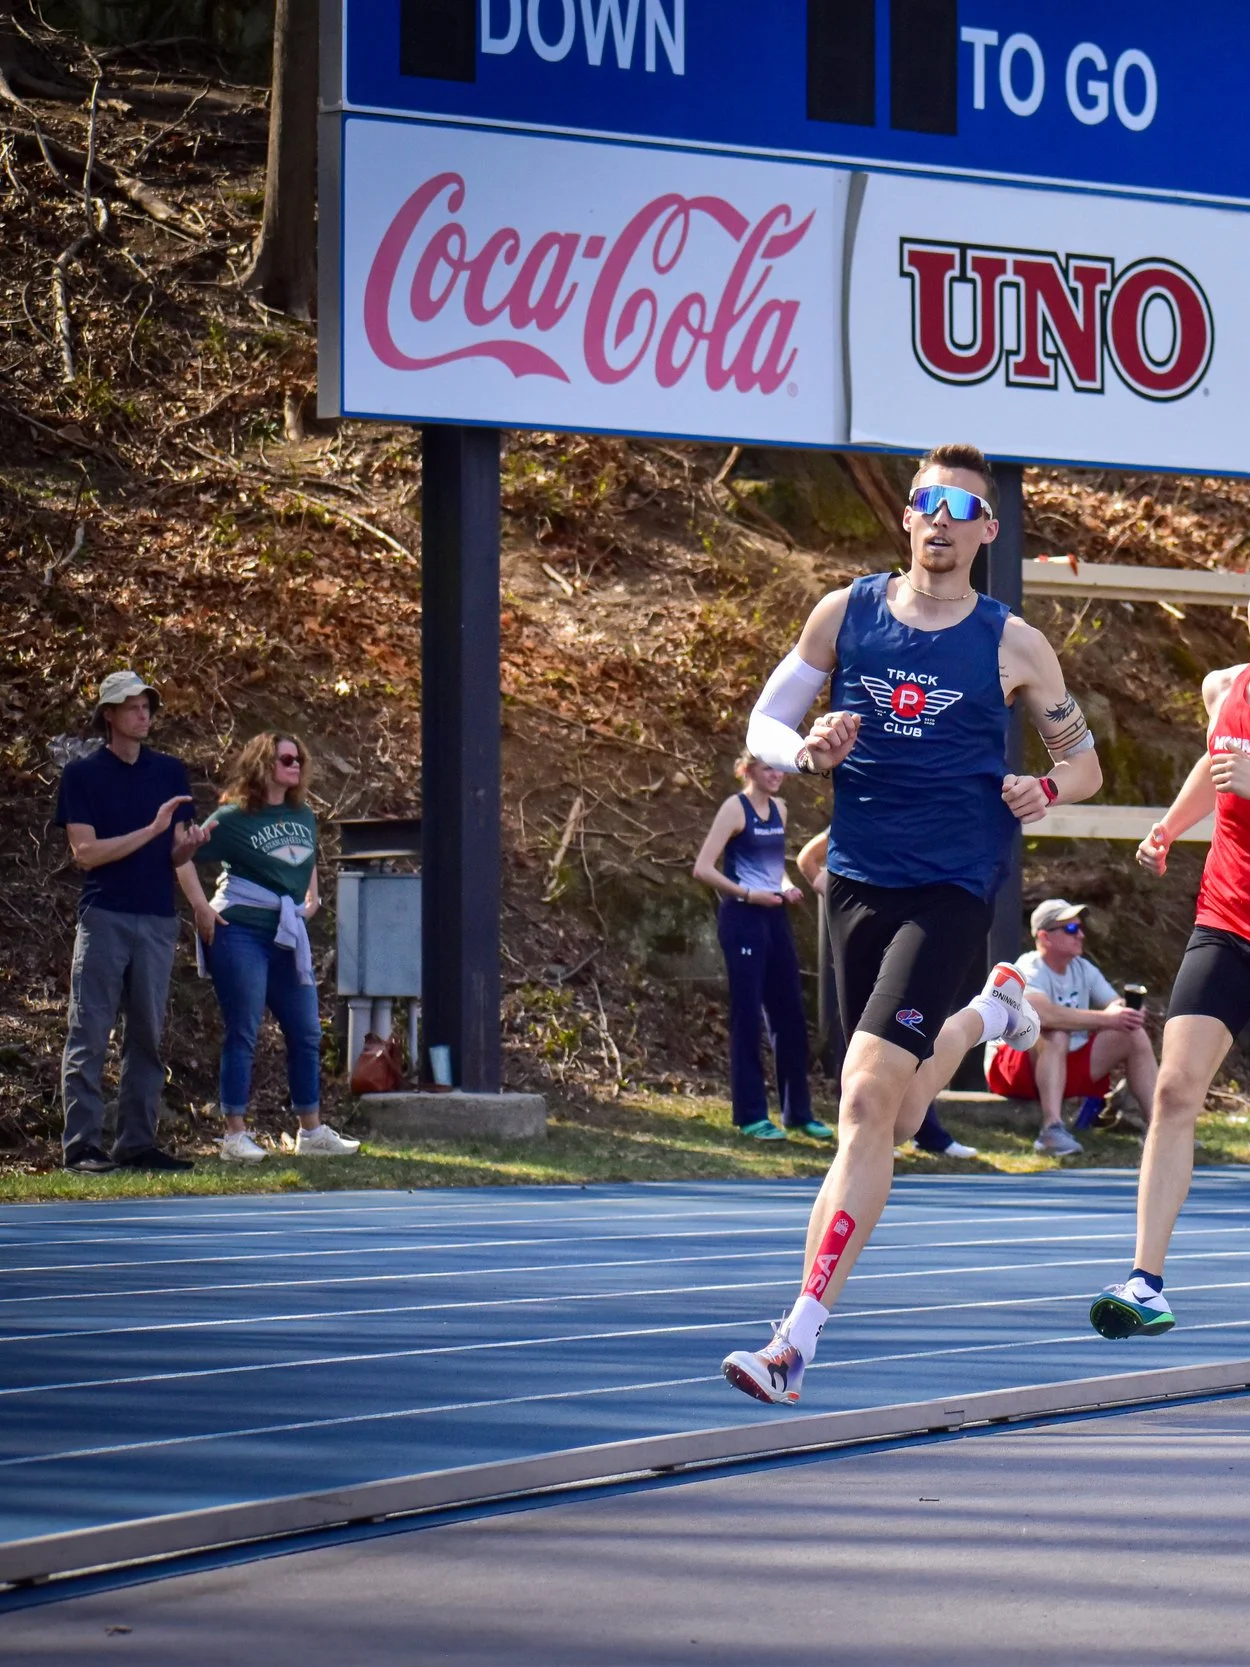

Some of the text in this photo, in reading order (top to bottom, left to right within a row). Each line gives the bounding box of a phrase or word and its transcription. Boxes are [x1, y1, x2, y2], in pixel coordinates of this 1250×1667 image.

[480, 0, 685, 75] DOWN
[961, 27, 1157, 131] TO GO
[363, 172, 817, 396] Coca-Cola
[899, 237, 1213, 402] UNO
[887, 668, 938, 686] TRACK
[883, 722, 922, 737] CLUB
[251, 823, 283, 849] PARK
